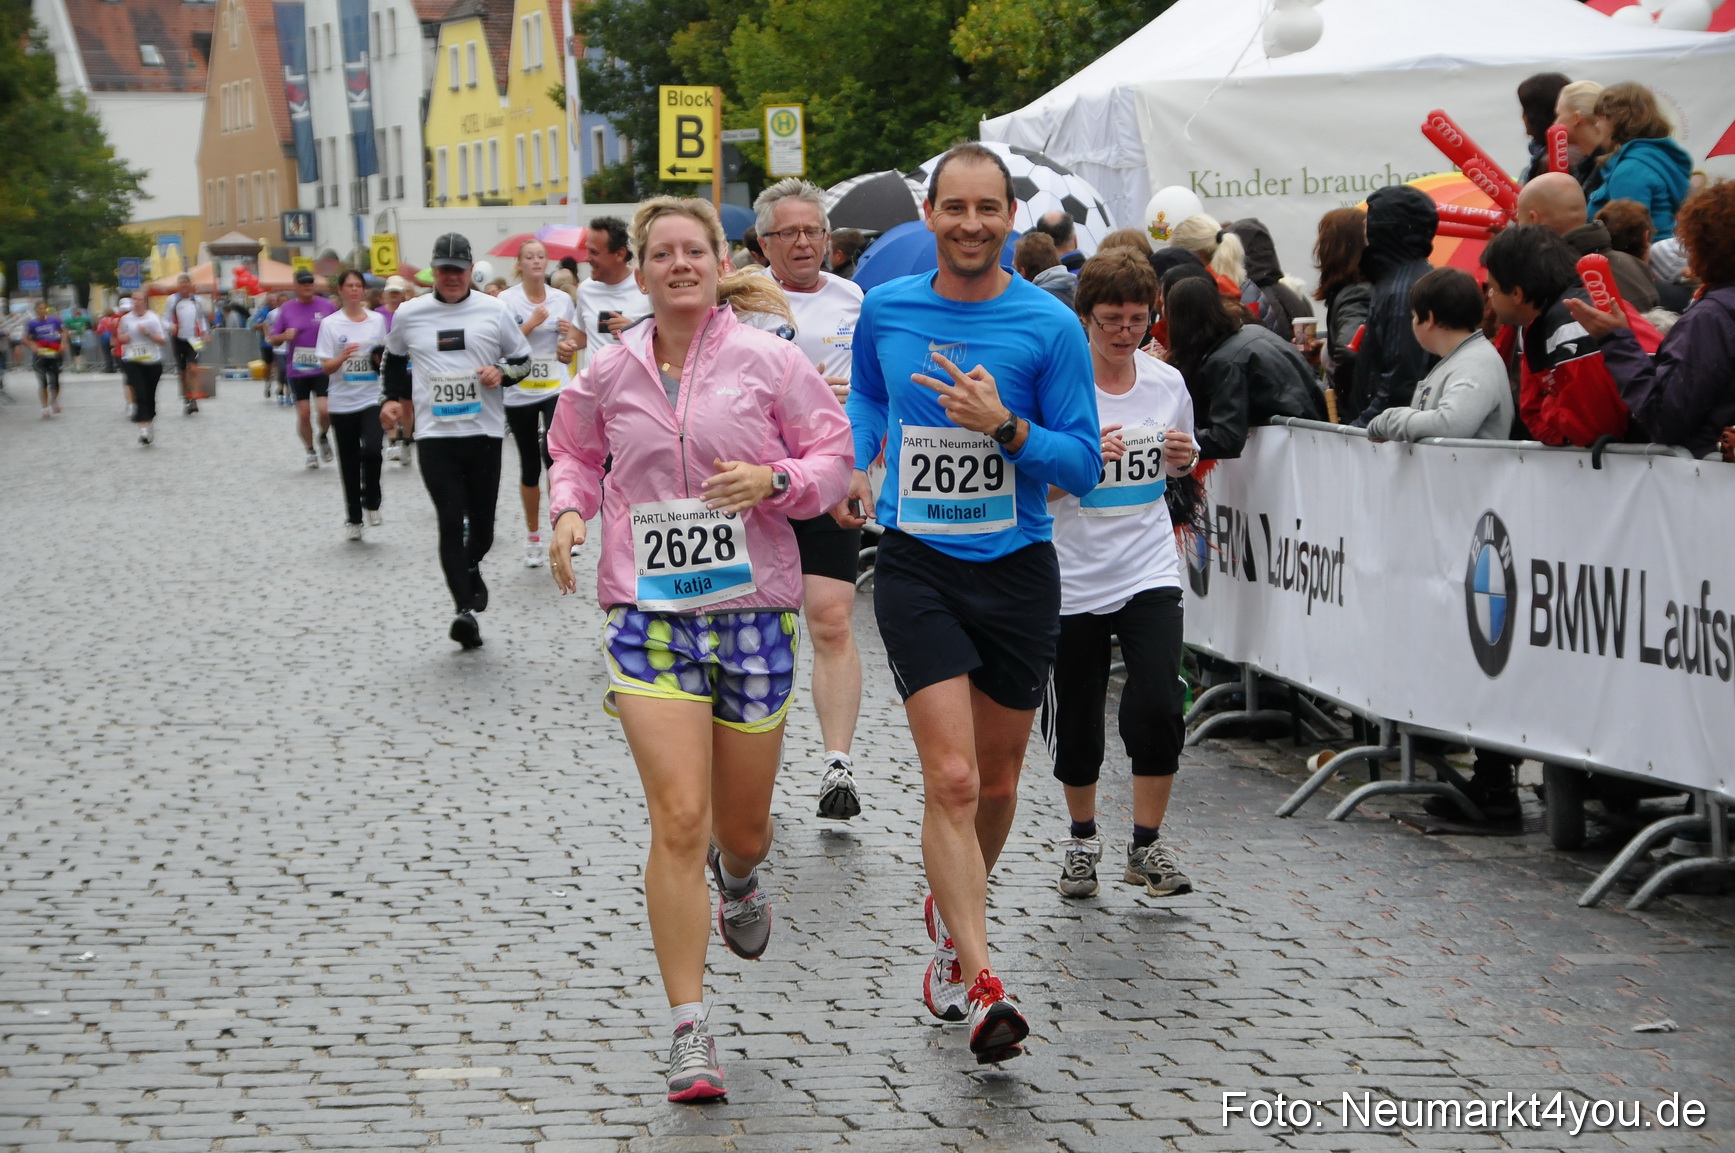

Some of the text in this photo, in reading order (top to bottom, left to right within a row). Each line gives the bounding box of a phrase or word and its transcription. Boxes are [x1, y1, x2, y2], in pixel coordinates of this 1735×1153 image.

[667, 90, 714, 107] Block
[776, 115, 791, 131] H
[676, 114, 705, 159] B
[1188, 168, 1292, 198] Kinder
[377, 246, 391, 266] C
[346, 359, 372, 372] 288
[433, 381, 477, 402] 2994
[903, 437, 994, 449] PARTL Neumarkt
[911, 453, 1004, 493] 2629
[1099, 447, 1162, 484] 153
[633, 509, 720, 525] PARTL Neumarkt
[927, 503, 987, 520] Michael
[644, 523, 736, 570] 2628
[673, 576, 713, 595] Katja
[1530, 558, 1735, 683] BMW Laufs
